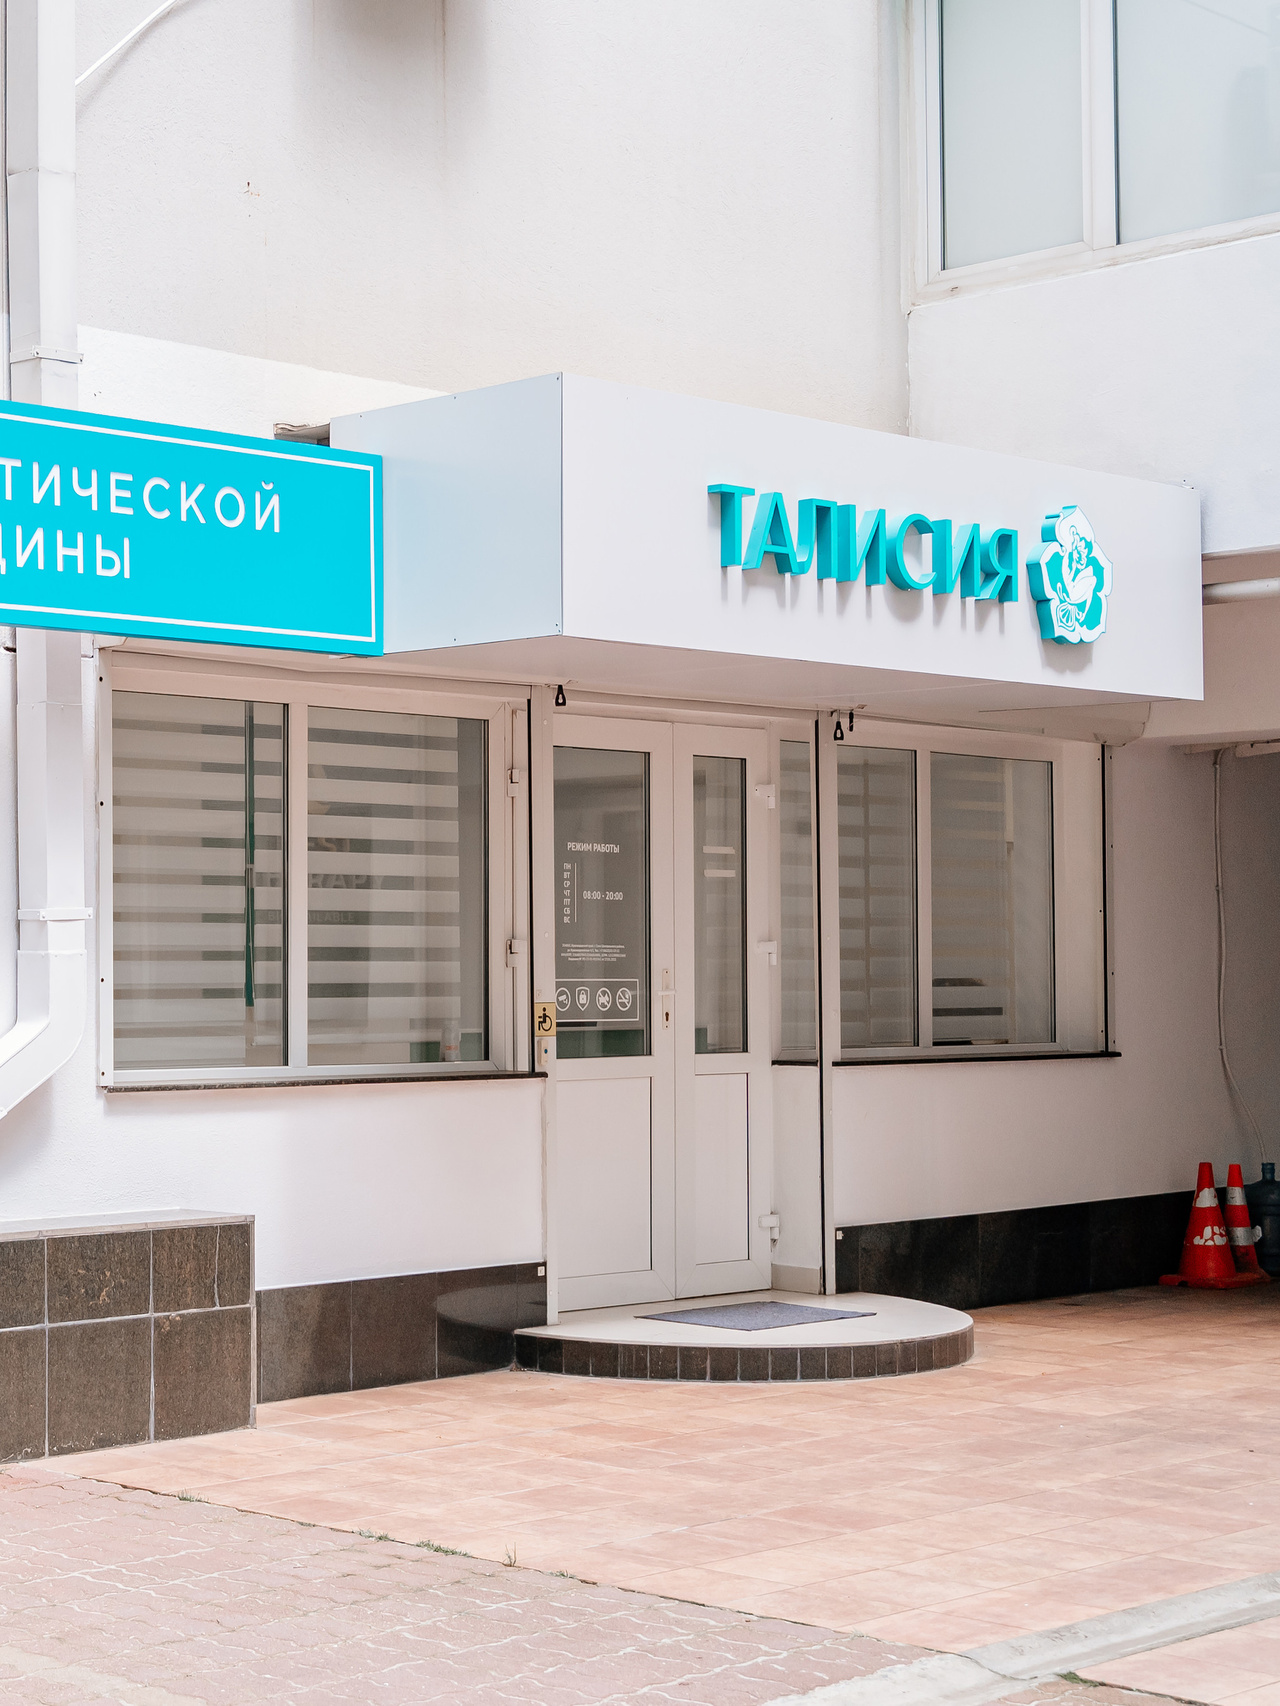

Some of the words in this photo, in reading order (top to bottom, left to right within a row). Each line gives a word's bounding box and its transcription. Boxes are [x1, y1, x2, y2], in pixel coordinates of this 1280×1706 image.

[707, 483, 1019, 603] ТАЛИСИЯ
[567, 842, 592, 852] РЕЖИМ
[593, 843, 620, 853] РАБОТЫ
[563, 880, 570, 888] СР
[563, 889, 570, 897] ЧТ
